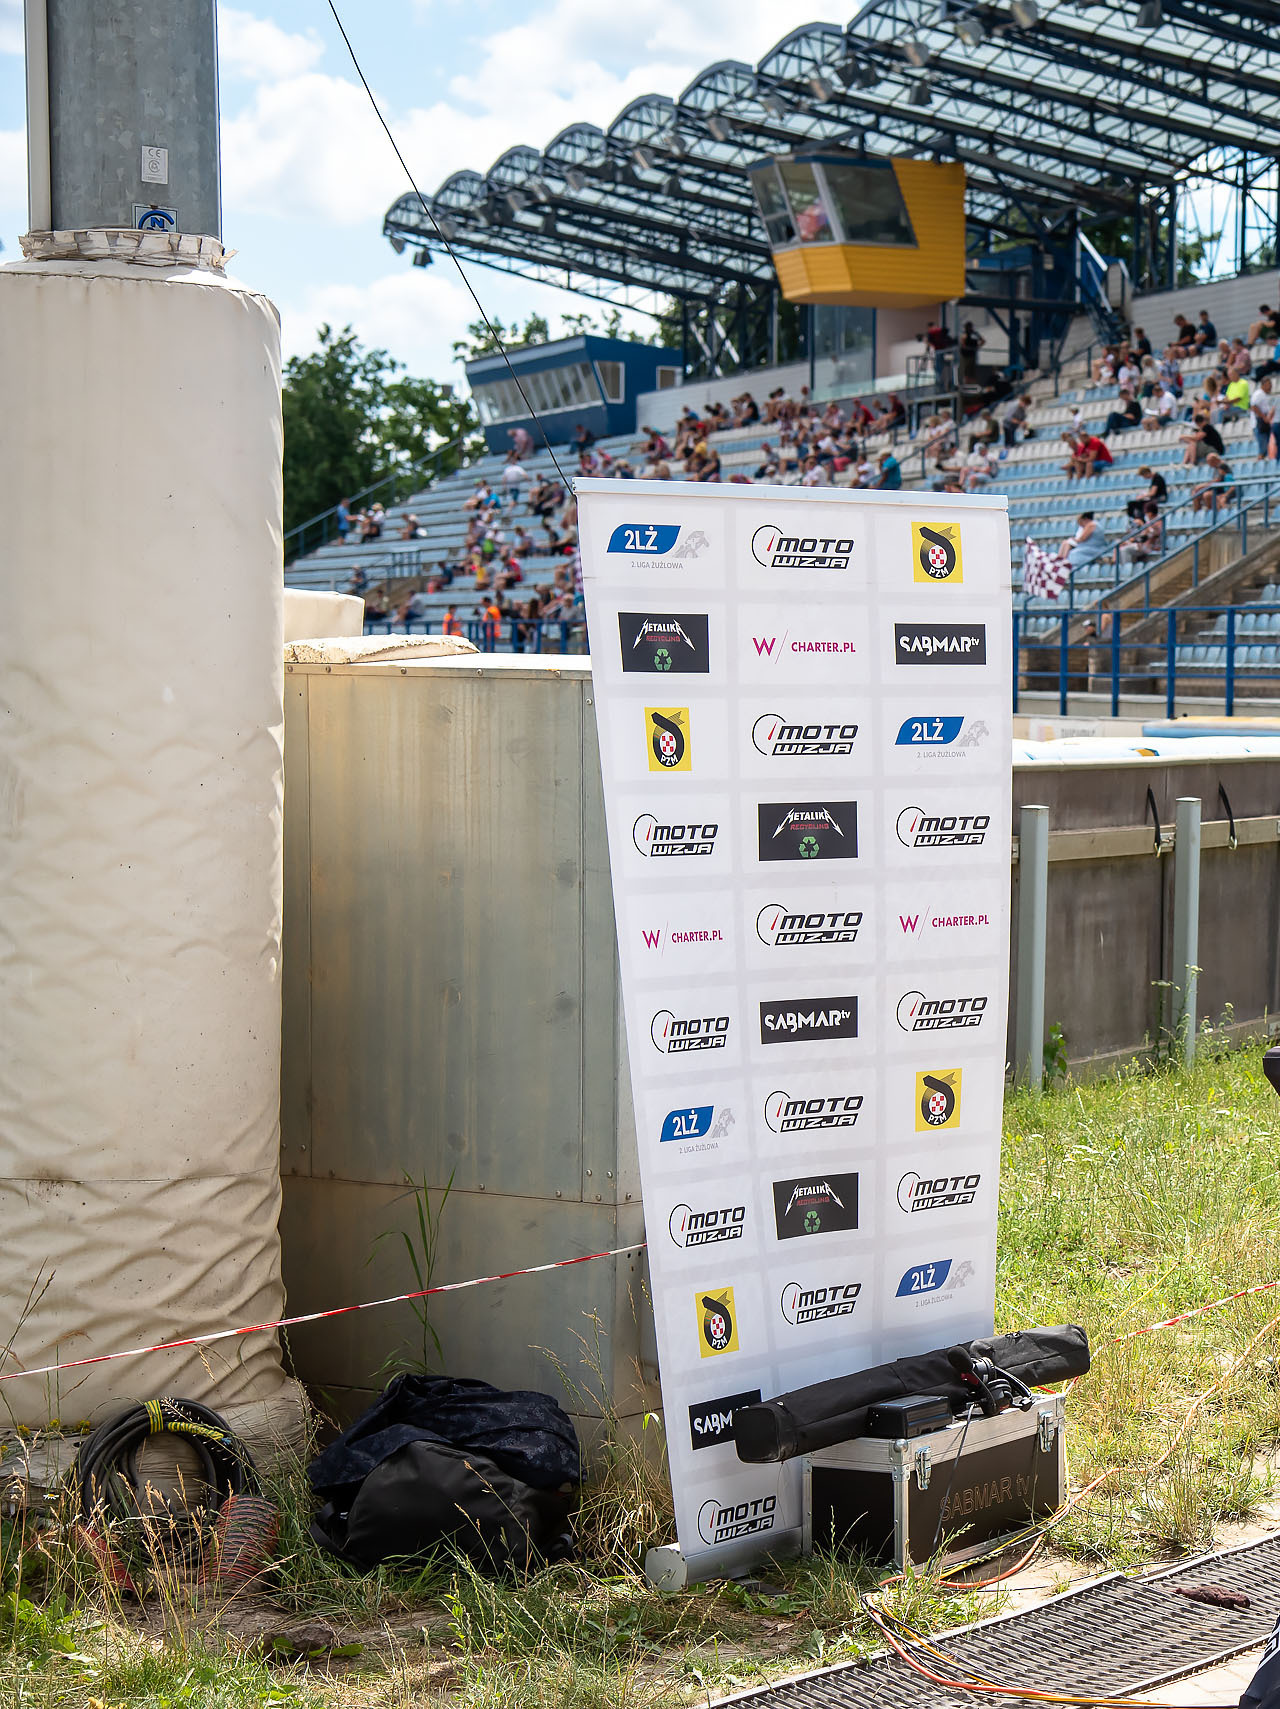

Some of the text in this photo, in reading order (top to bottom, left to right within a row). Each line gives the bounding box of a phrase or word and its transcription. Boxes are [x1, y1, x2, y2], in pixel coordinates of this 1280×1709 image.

[625, 526, 658, 551] 2LŻ
[775, 538, 854, 554] MOTO
[774, 556, 848, 569] WIZJA
[929, 566, 949, 577] PZM
[753, 637, 856, 656] W CHARTER.PL
[778, 725, 858, 740] MOTO
[912, 718, 944, 741] 2LŻ
[774, 743, 852, 755] WIZJA
[661, 754, 678, 765] PZM
[653, 823, 718, 840] MOTO
[920, 816, 990, 831] MOTO
[915, 834, 983, 847] WIZJA
[651, 843, 713, 857] WIZJA
[780, 912, 863, 930] MOTO
[899, 915, 990, 933] W CHARTER.PL
[642, 929, 723, 949] W CHARTER.PL
[776, 930, 858, 944] WIZJA
[917, 997, 987, 1015] MOTO
[670, 1017, 730, 1036] MOTO
[913, 1015, 983, 1031] WIZJA
[668, 1036, 726, 1052] WIZJA
[783, 1095, 864, 1115] MOTO
[673, 1109, 699, 1137] 2LŻ
[780, 1115, 858, 1132] WIZJA
[928, 1113, 947, 1124] PZM
[914, 1174, 981, 1193] MOTO
[911, 1194, 976, 1212] WIZJA
[687, 1206, 745, 1227] MOTO
[686, 1227, 743, 1247] WIZJA
[911, 1264, 936, 1291] 2LŻ
[798, 1283, 862, 1307] MOTO
[796, 1302, 856, 1324] WIZJA
[712, 1336, 727, 1348] PZM
[940, 1477, 1012, 1521] SABMAR
[717, 1496, 776, 1522] MOTO
[715, 1516, 774, 1542] WIZJA
